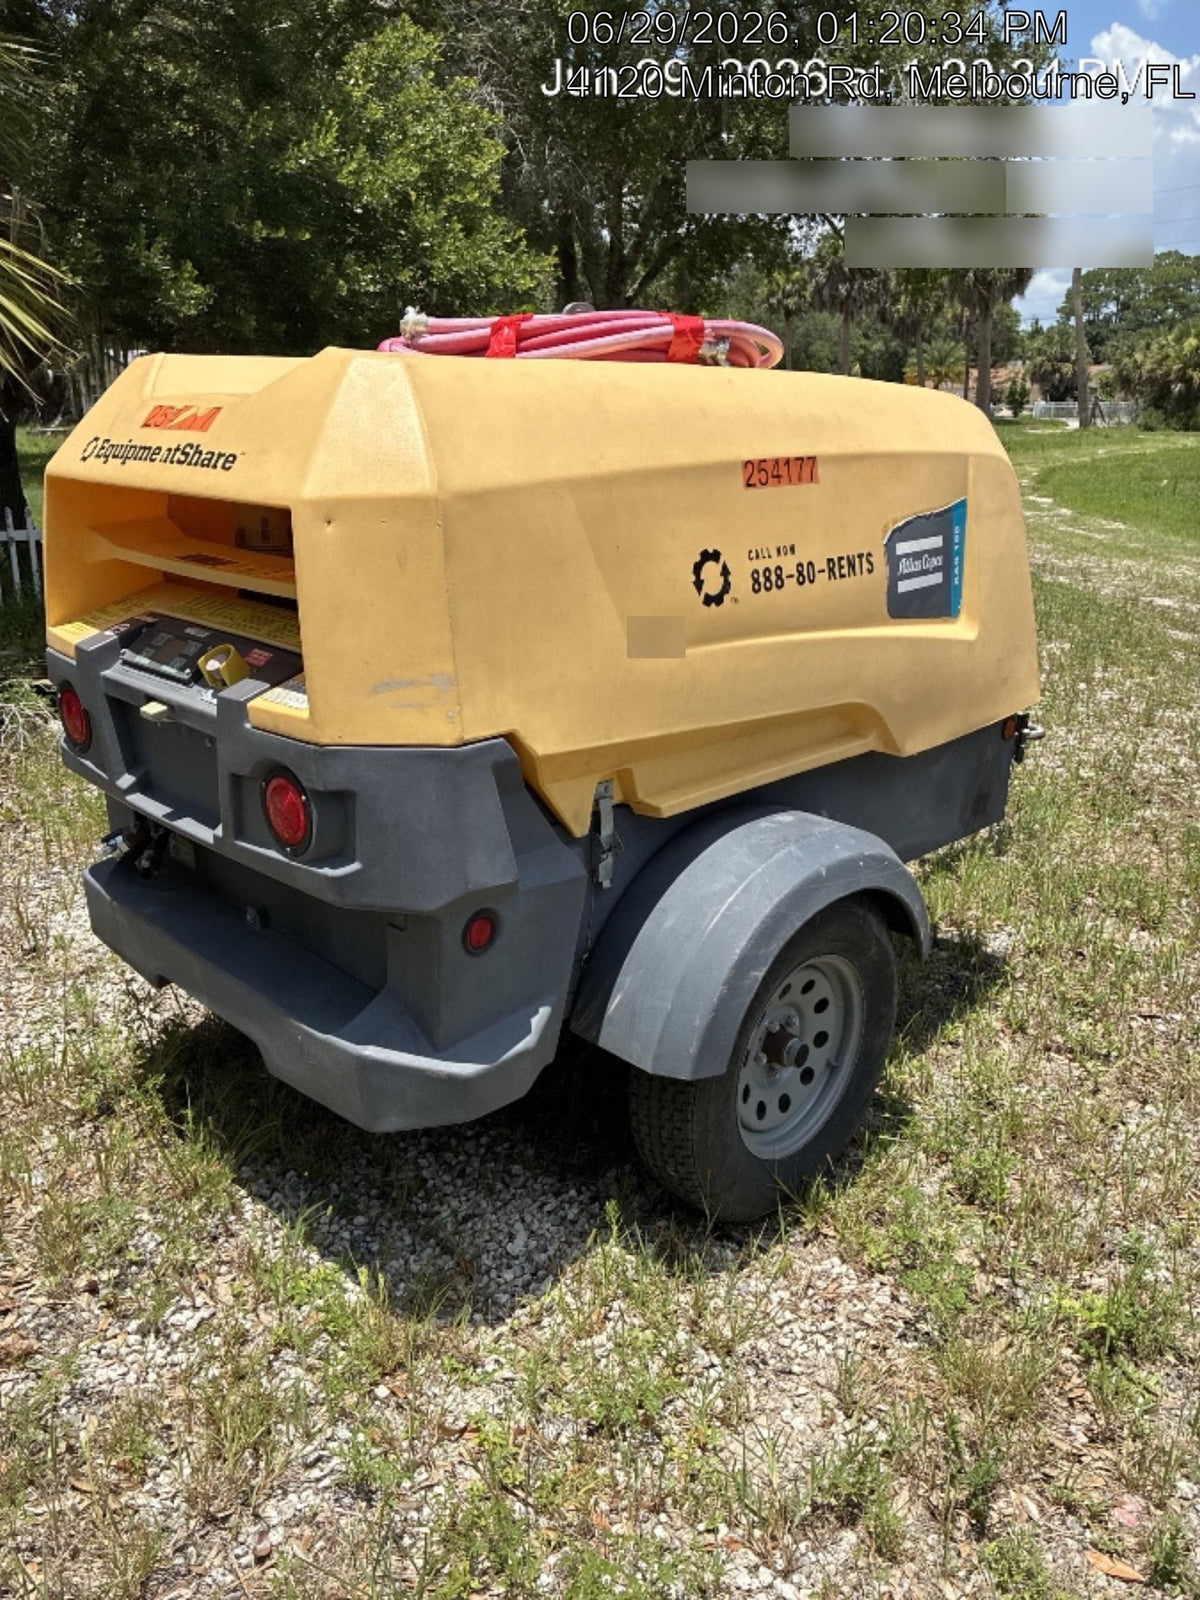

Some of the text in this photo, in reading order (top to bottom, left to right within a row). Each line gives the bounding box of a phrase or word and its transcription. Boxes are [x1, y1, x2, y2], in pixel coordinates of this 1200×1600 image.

[95, 437, 238, 472] EquipmentShare
[744, 456, 818, 488] 254177
[748, 544, 796, 562] CALL NOW
[897, 556, 922, 576] Atlas
[750, 551, 875, 595] 888-80-RENTS
